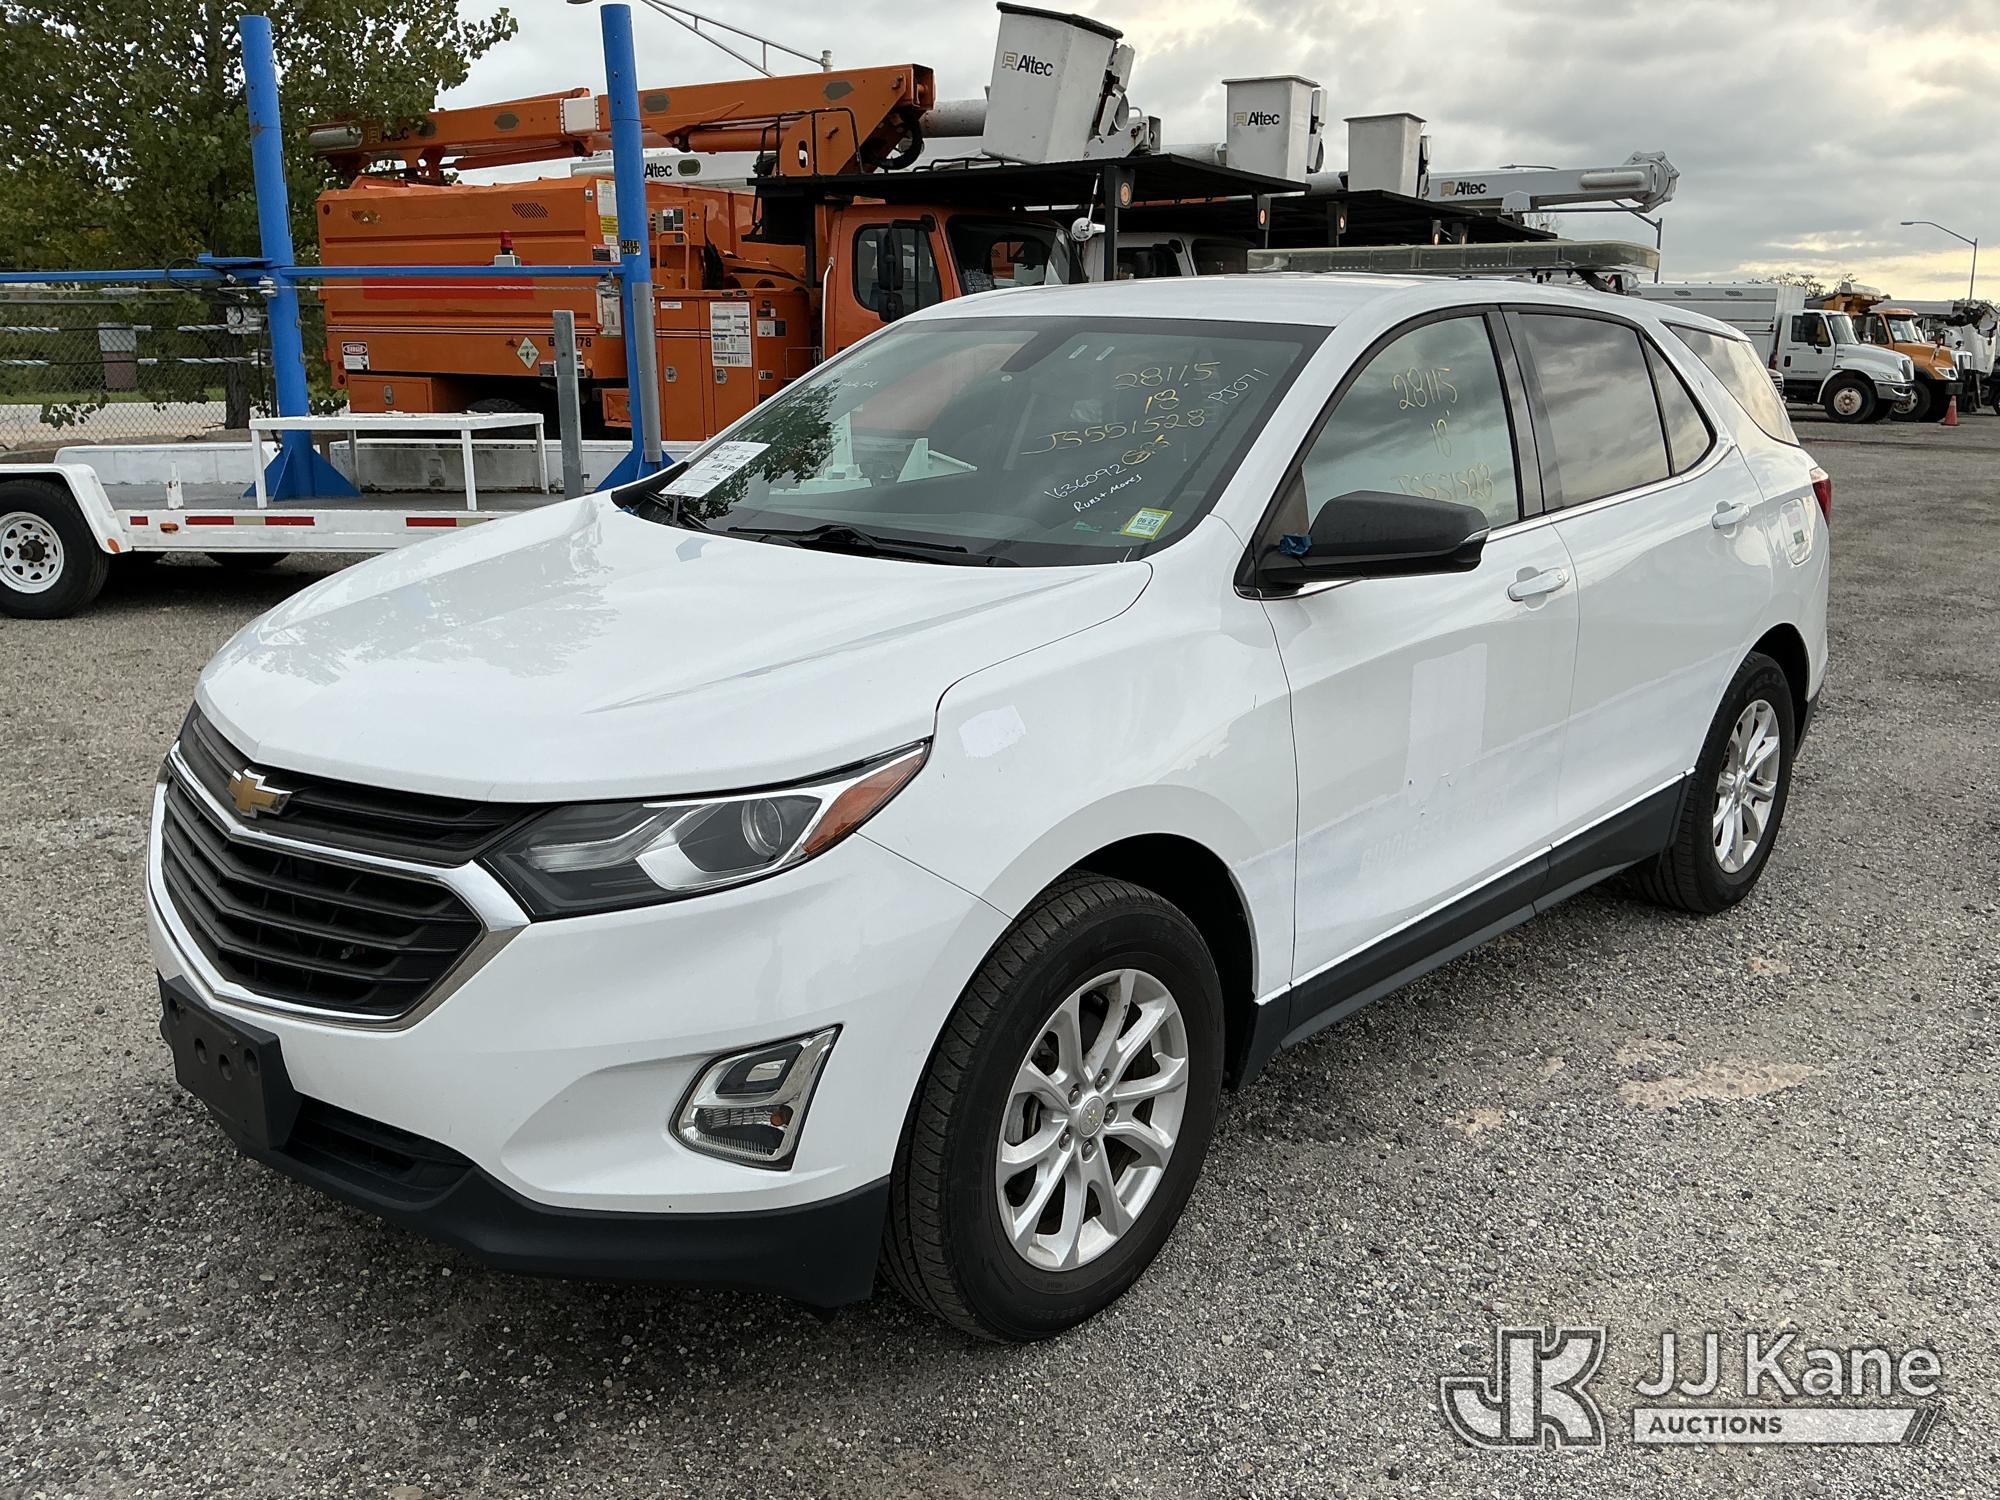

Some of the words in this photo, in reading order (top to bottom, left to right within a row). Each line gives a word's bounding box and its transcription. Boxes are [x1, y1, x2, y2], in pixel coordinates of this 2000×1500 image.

[1016, 54, 1054, 77] Altec
[1247, 111, 1280, 126] Altec
[644, 162, 672, 178] Altec
[1454, 181, 1487, 195] Altec
[1392, 366, 1457, 410] 28115
